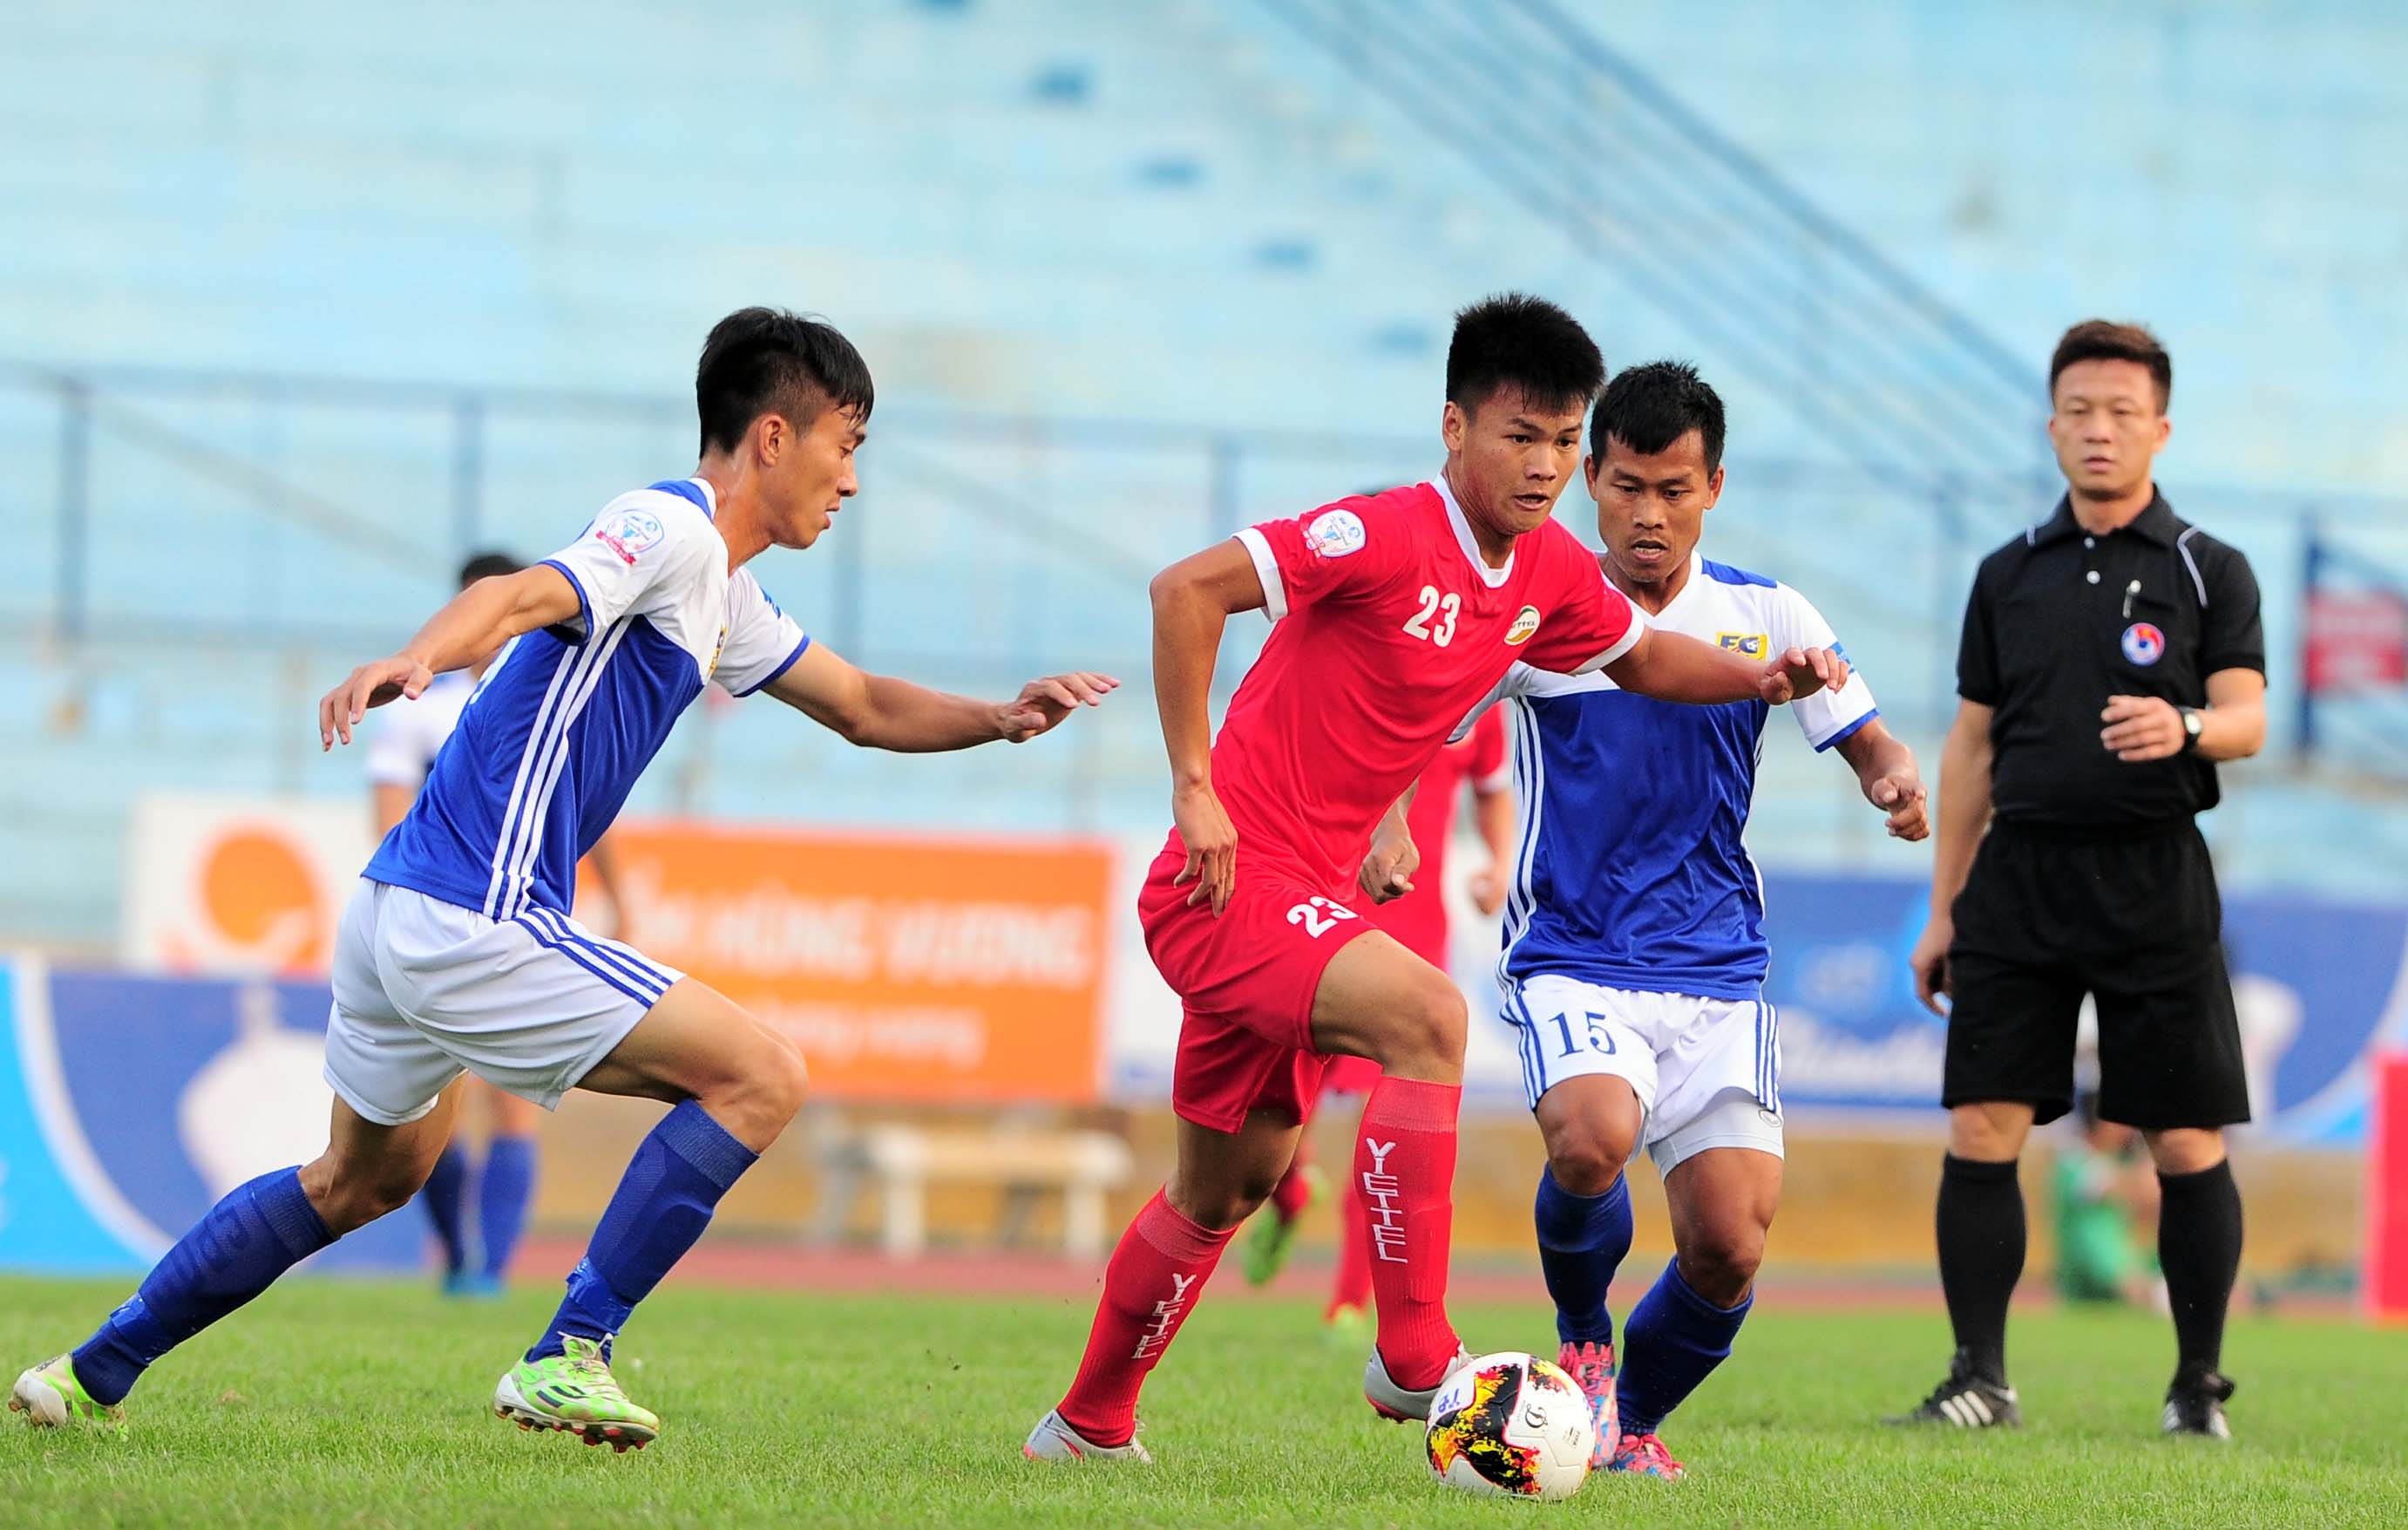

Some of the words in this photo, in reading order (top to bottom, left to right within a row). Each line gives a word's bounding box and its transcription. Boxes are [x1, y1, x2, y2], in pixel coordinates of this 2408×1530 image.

[1401, 584, 1462, 648] 23
[1285, 895, 1360, 939] 23
[1548, 1010, 1617, 1058] 15
